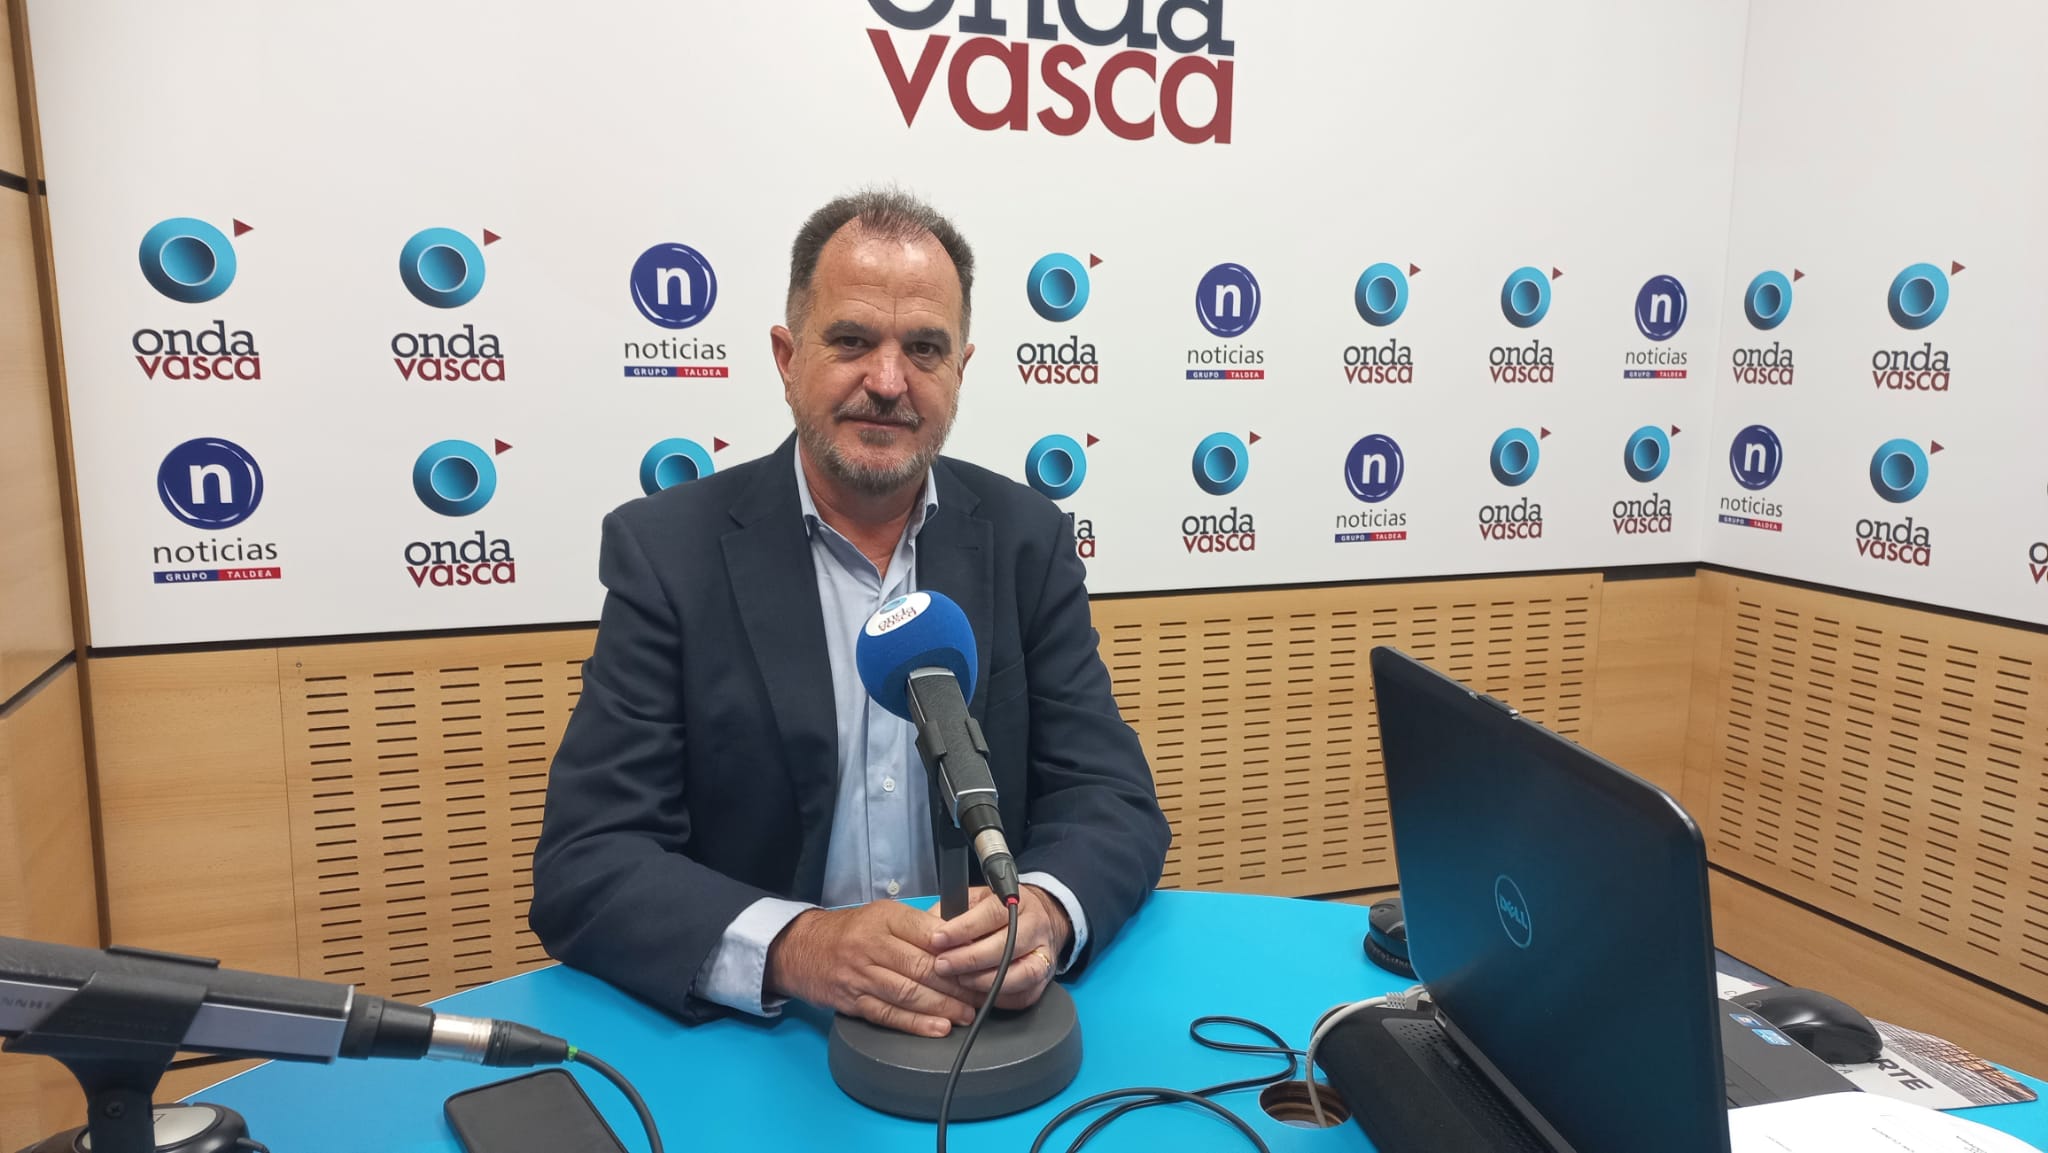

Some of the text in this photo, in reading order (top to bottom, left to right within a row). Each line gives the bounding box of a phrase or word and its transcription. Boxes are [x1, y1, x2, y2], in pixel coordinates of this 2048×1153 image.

[866, 28, 1235, 145] vasca
[655, 265, 692, 306] n
[1214, 285, 1242, 318] n
[1650, 293, 1672, 323] n
[133, 320, 259, 356] onda
[392, 324, 504, 358] onda
[625, 337, 726, 359] noticias
[1017, 336, 1098, 365] onda
[1188, 345, 1263, 364] noticias
[1344, 339, 1413, 366] onda
[1490, 340, 1554, 368] onda
[1626, 347, 1687, 364] noticias
[1733, 342, 1793, 369] onda
[1873, 343, 1950, 371] onda
[137, 355, 261, 380] vasca
[395, 357, 505, 381] vasca
[633, 367, 722, 377] GRUPO TALDEA
[1020, 364, 1098, 384] vasca
[1193, 371, 1260, 379] GRUPO TALDEA
[1344, 364, 1413, 384] vasca
[1490, 364, 1554, 383] vasca
[1733, 366, 1794, 385] vasca
[1873, 371, 1949, 391] vasca
[1362, 452, 1387, 485] n
[1744, 442, 1766, 473] n
[189, 463, 233, 505] n
[1337, 509, 1406, 528] noticias
[1479, 497, 1542, 524] onda
[1613, 493, 1672, 518] onda
[1720, 496, 1783, 517] noticias
[1182, 507, 1255, 536] onda
[1480, 520, 1542, 540] vasca
[1613, 515, 1672, 534] vasca
[1856, 517, 1931, 548] onda
[154, 538, 278, 563] noticias
[405, 531, 514, 566] onda
[1183, 532, 1256, 553] vasca
[1341, 532, 1402, 542] GRUPO TALDEA
[1856, 538, 1931, 567] vasca
[165, 569, 273, 582] GRUPO TALDEA
[407, 560, 516, 588] vasca
[1500, 895, 1528, 930] DELL
[1876, 1058, 1934, 1091] RTE
